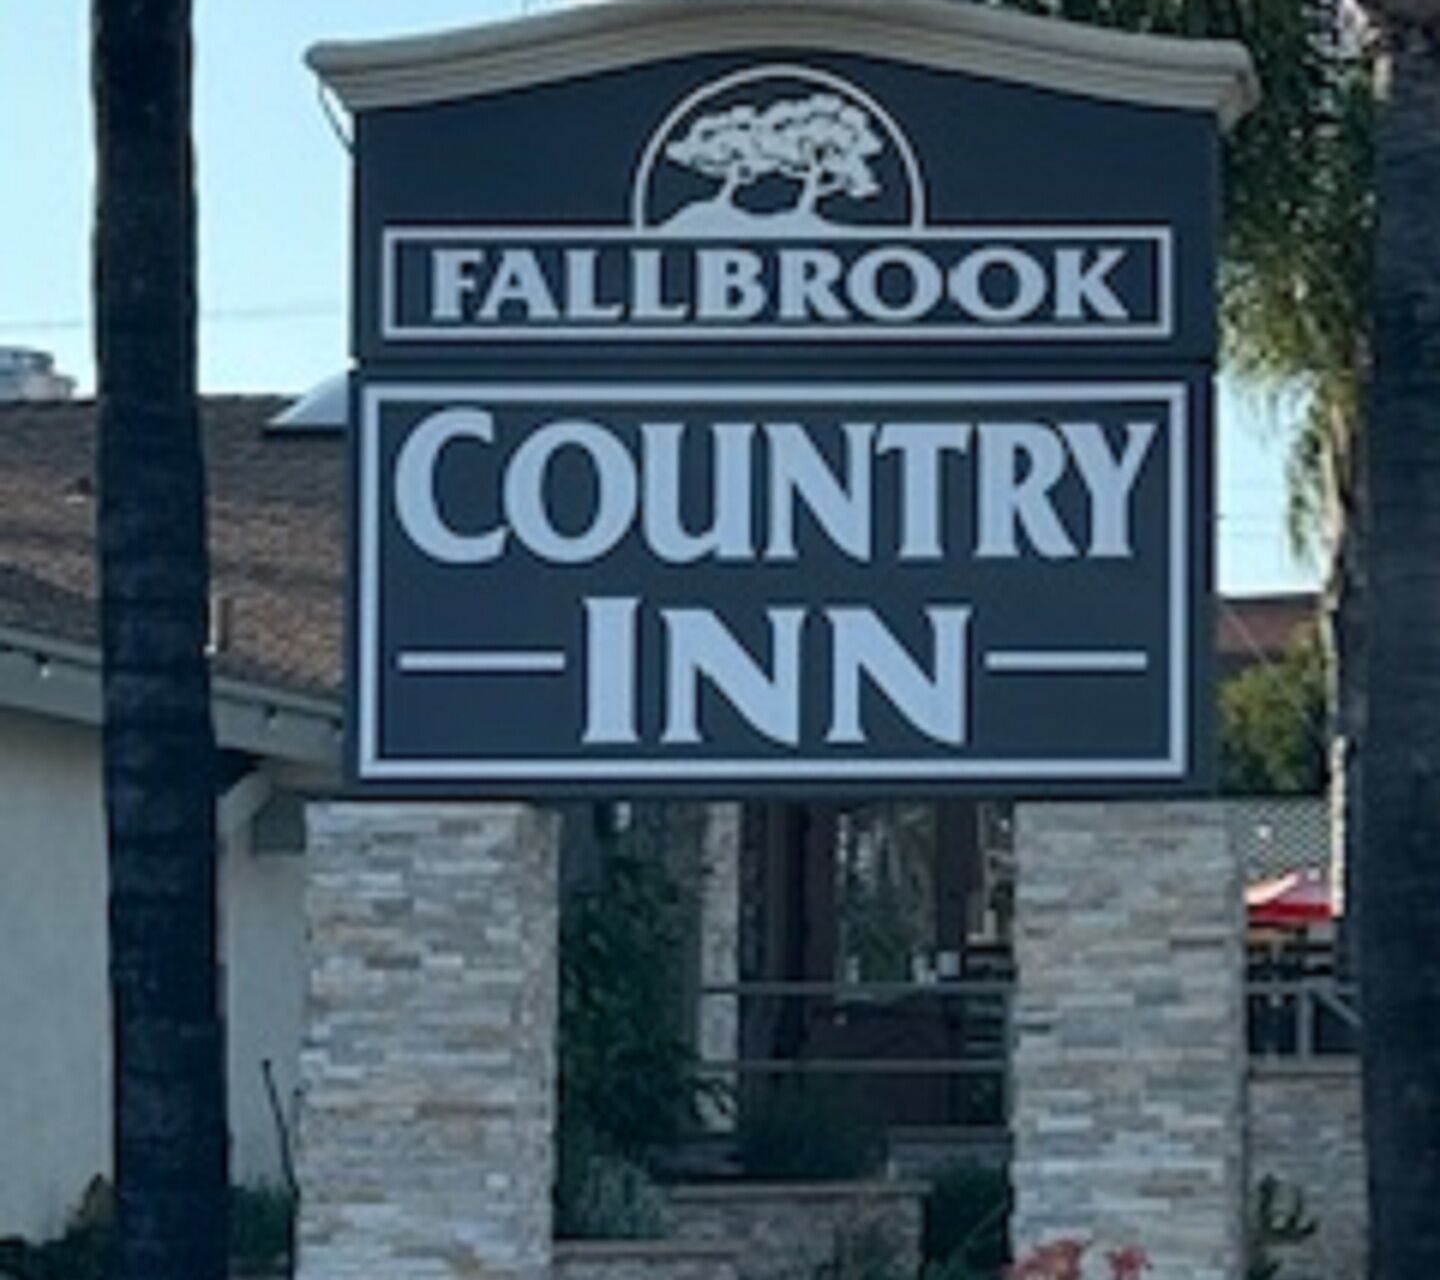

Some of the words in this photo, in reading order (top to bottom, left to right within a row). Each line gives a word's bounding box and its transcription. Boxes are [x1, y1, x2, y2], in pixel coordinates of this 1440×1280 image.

[432, 248, 1128, 320] FALLBROOK
[395, 408, 1156, 563] COUNTRY
[582, 597, 971, 745] INN
